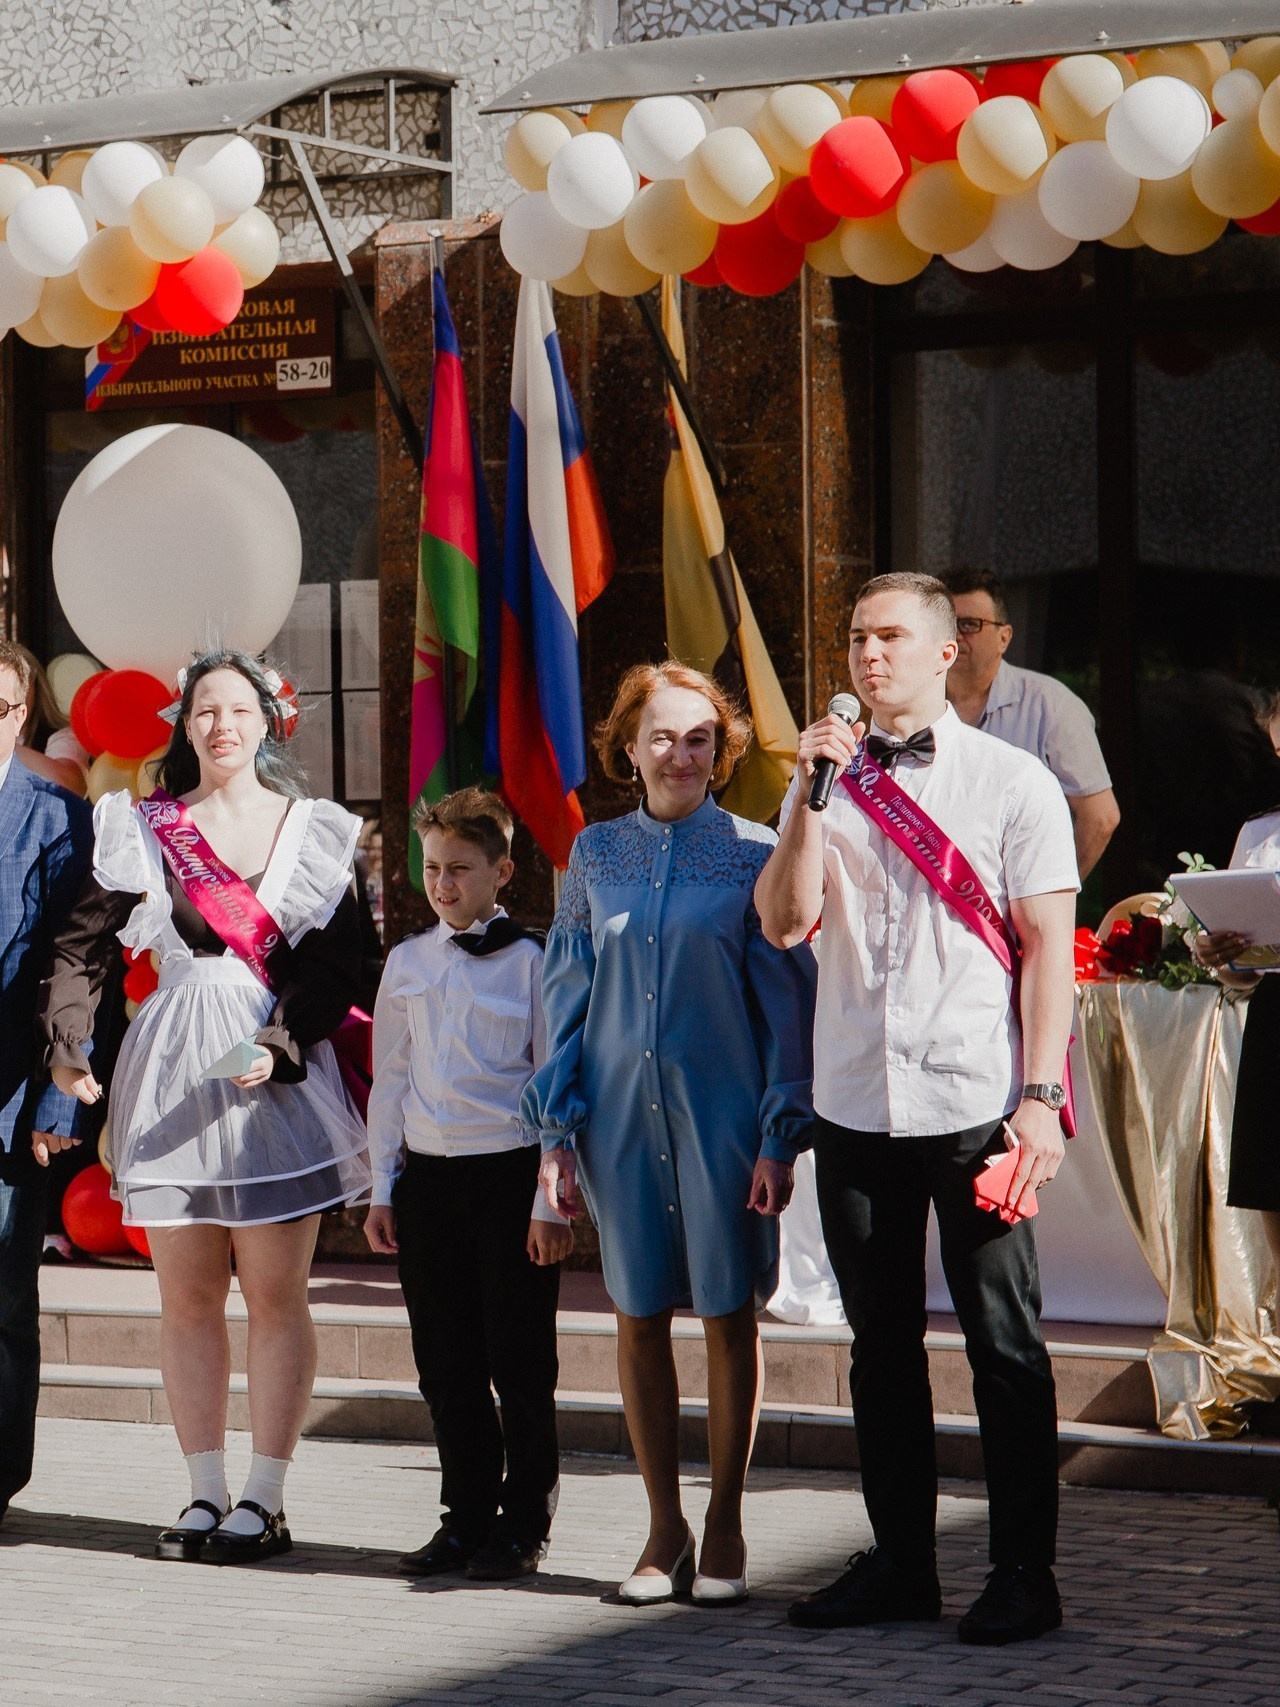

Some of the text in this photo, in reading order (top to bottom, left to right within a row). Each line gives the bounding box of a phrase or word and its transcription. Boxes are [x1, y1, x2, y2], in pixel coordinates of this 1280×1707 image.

[152, 319, 317, 345] ИЗБАТЕЛЬНАЯ
[180, 342, 289, 364] КОМИССИЯ
[96, 377, 202, 398] ИЗБИРАТЕЛЬНОГО
[206, 373, 260, 390] УЧАСТКА
[278, 360, 330, 383] 58-20
[923, 828, 942, 852] Иван
[164, 826, 259, 937] Выпускница
